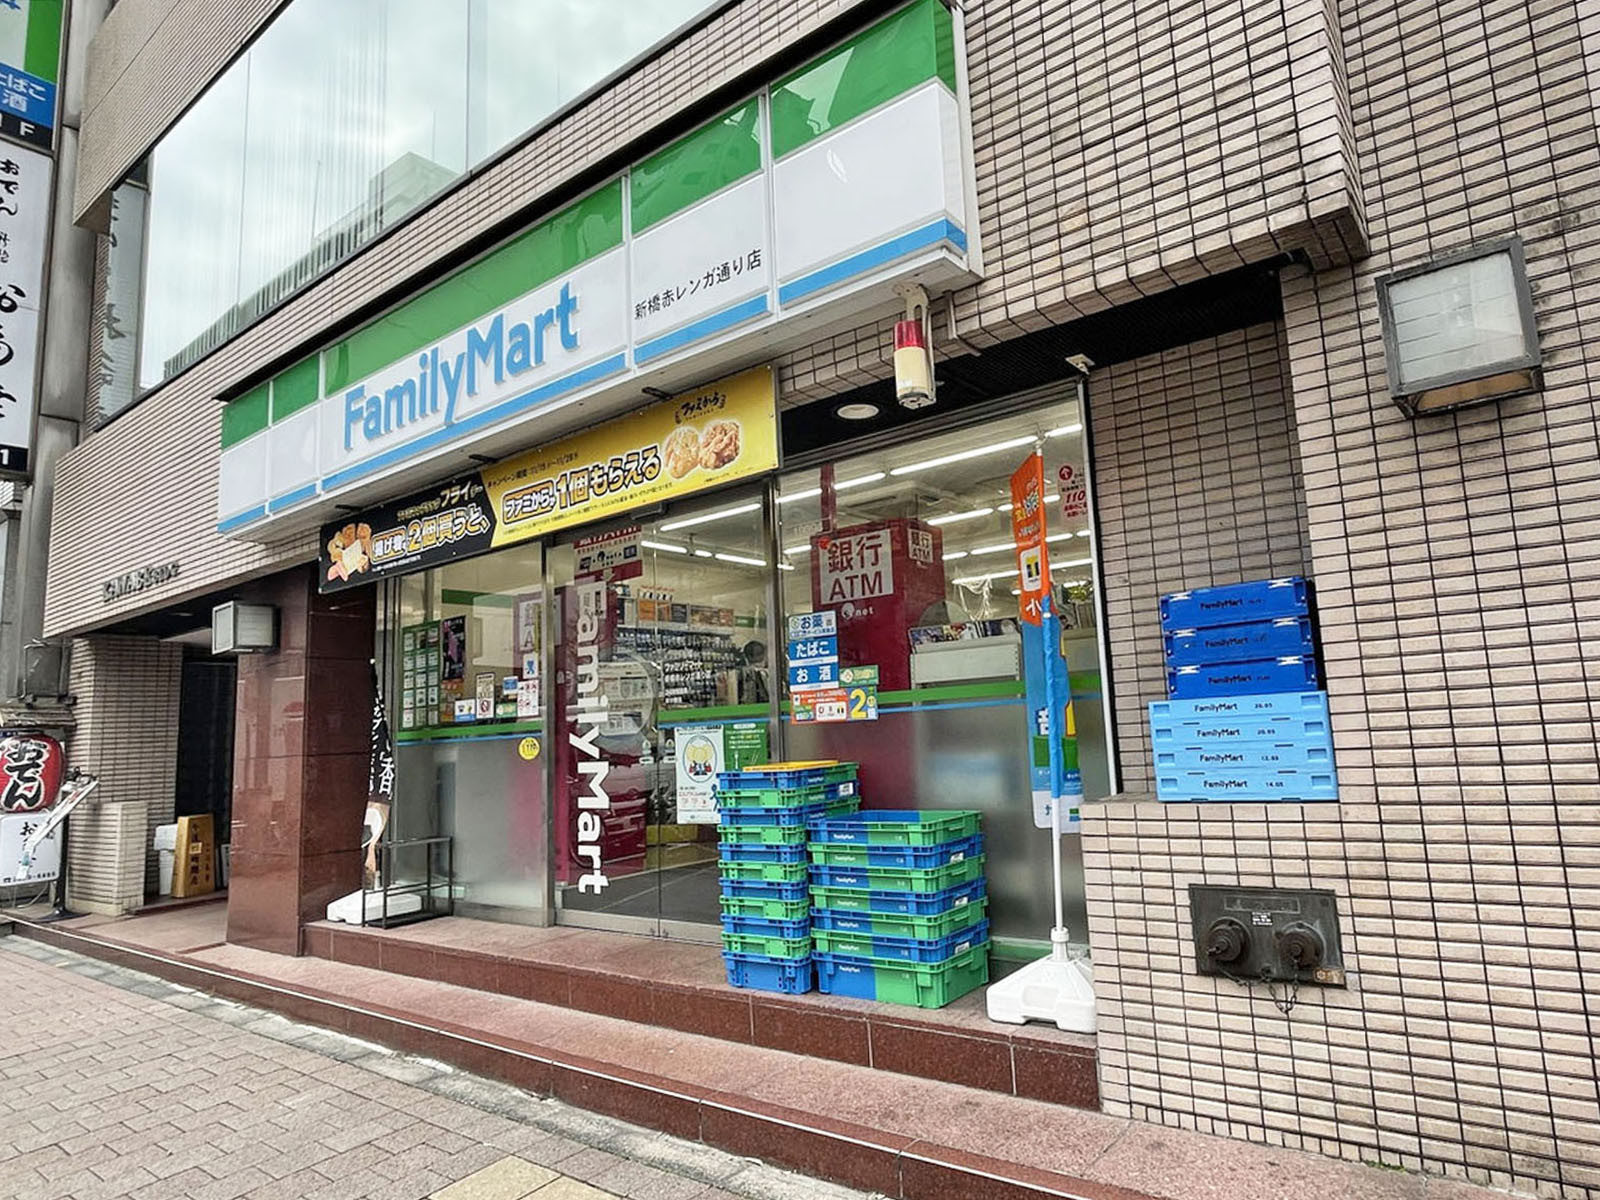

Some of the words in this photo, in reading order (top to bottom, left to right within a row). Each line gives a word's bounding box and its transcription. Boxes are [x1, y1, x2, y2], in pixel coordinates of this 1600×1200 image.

[634, 248, 762, 319] 新橋赤レンガ通り店
[344, 280, 580, 451] FamilyMart
[828, 534, 882, 573] 銀行
[829, 571, 883, 600] ATM
[796, 641, 830, 658] たばこ
[849, 688, 867, 719] 2
[1194, 703, 1238, 713] FamilyMart
[569, 580, 610, 895] FamilyMart
[1197, 729, 1240, 738] FamilyMart
[1200, 754, 1244, 764] FamilyMart
[3, 740, 48, 809] おでん
[1204, 780, 1248, 789] FamilyMart
